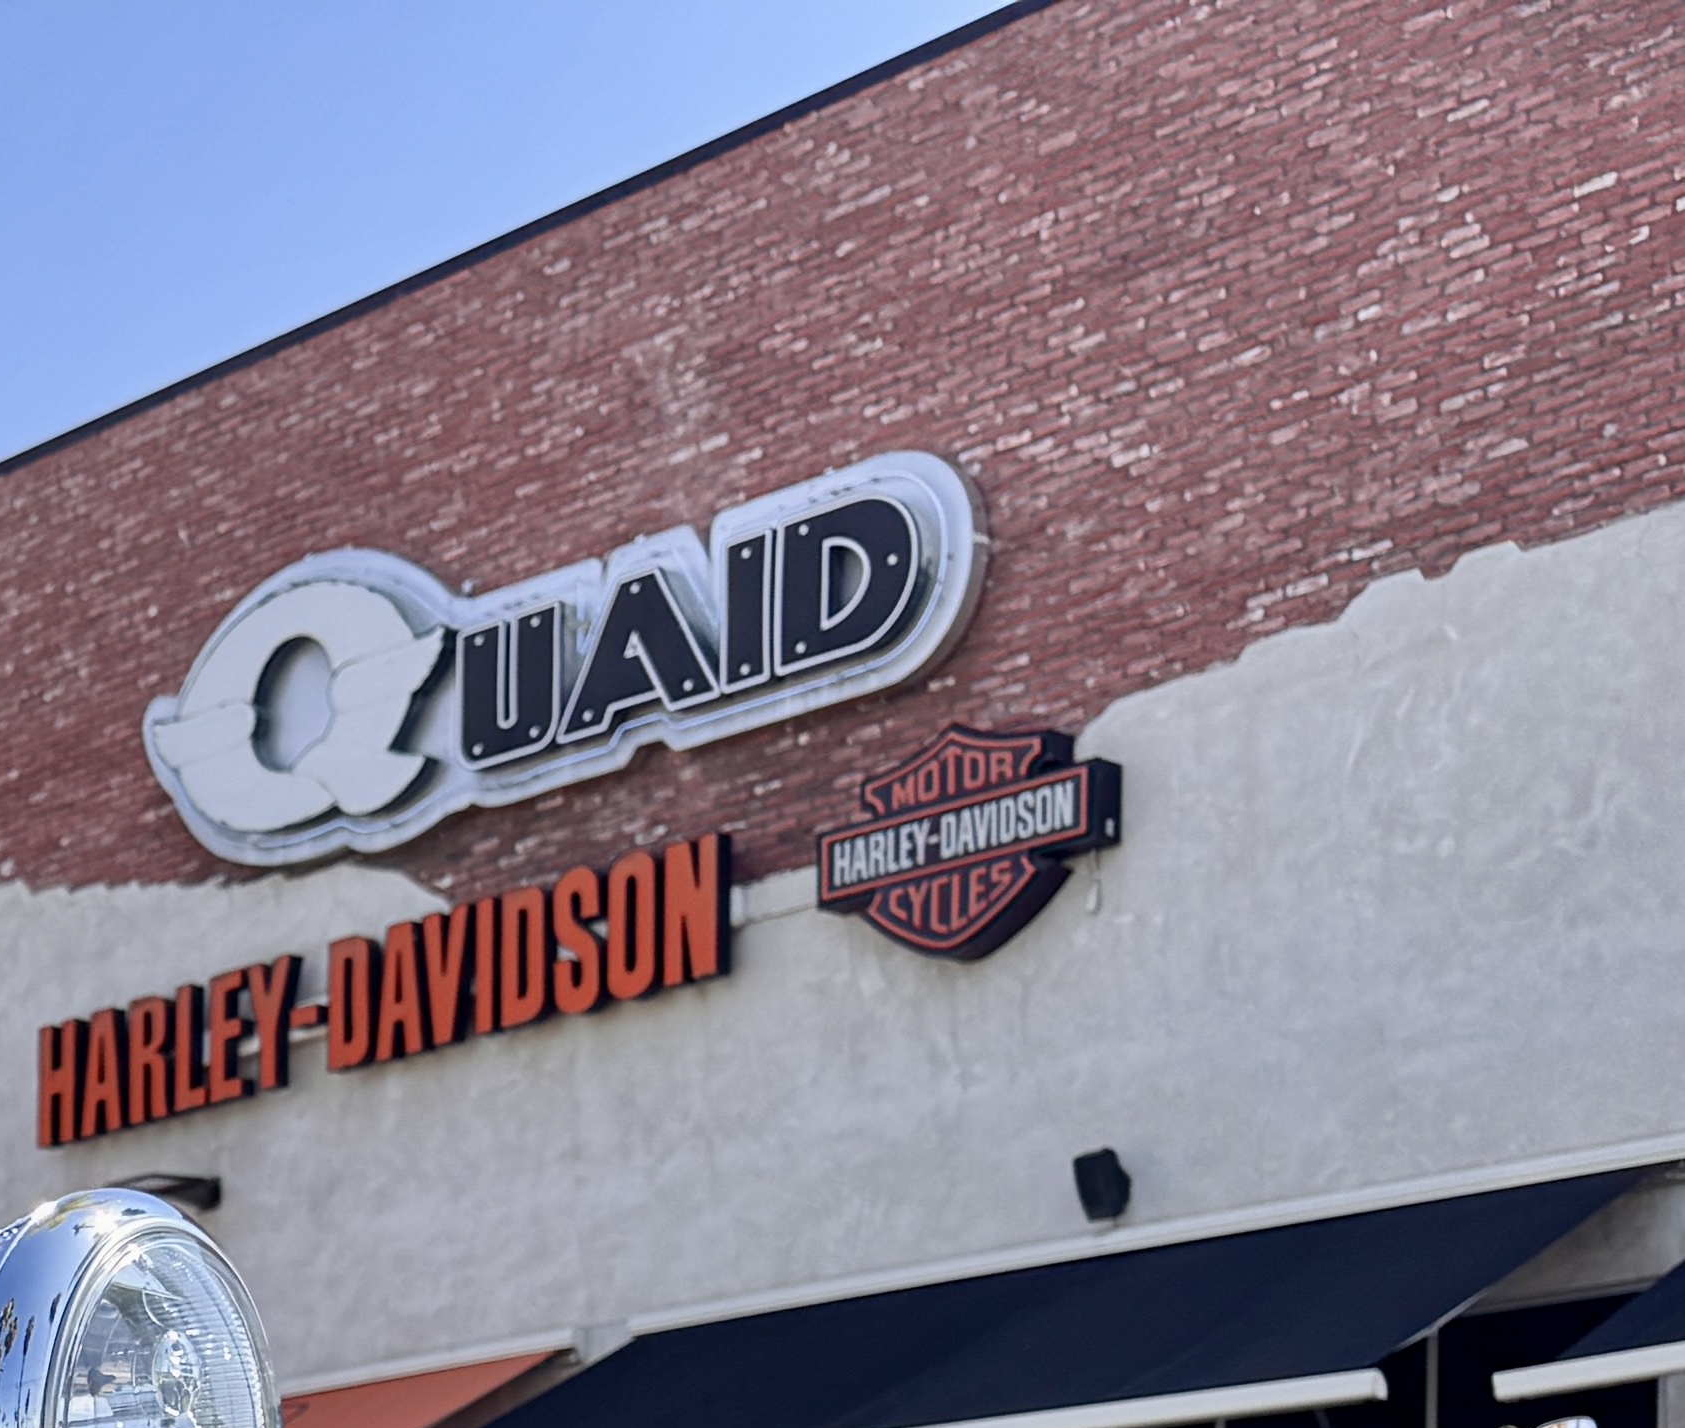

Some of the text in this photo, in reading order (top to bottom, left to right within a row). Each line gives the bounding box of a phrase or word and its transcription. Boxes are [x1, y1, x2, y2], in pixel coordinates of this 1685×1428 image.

[149, 492, 925, 836] QUAID
[891, 747, 1014, 810] MOTOR
[832, 781, 1076, 887] HARLEY-DAVIDSON
[888, 857, 1015, 935] CYCLES
[37, 836, 727, 1148] HARLEY-DAVIDSON
